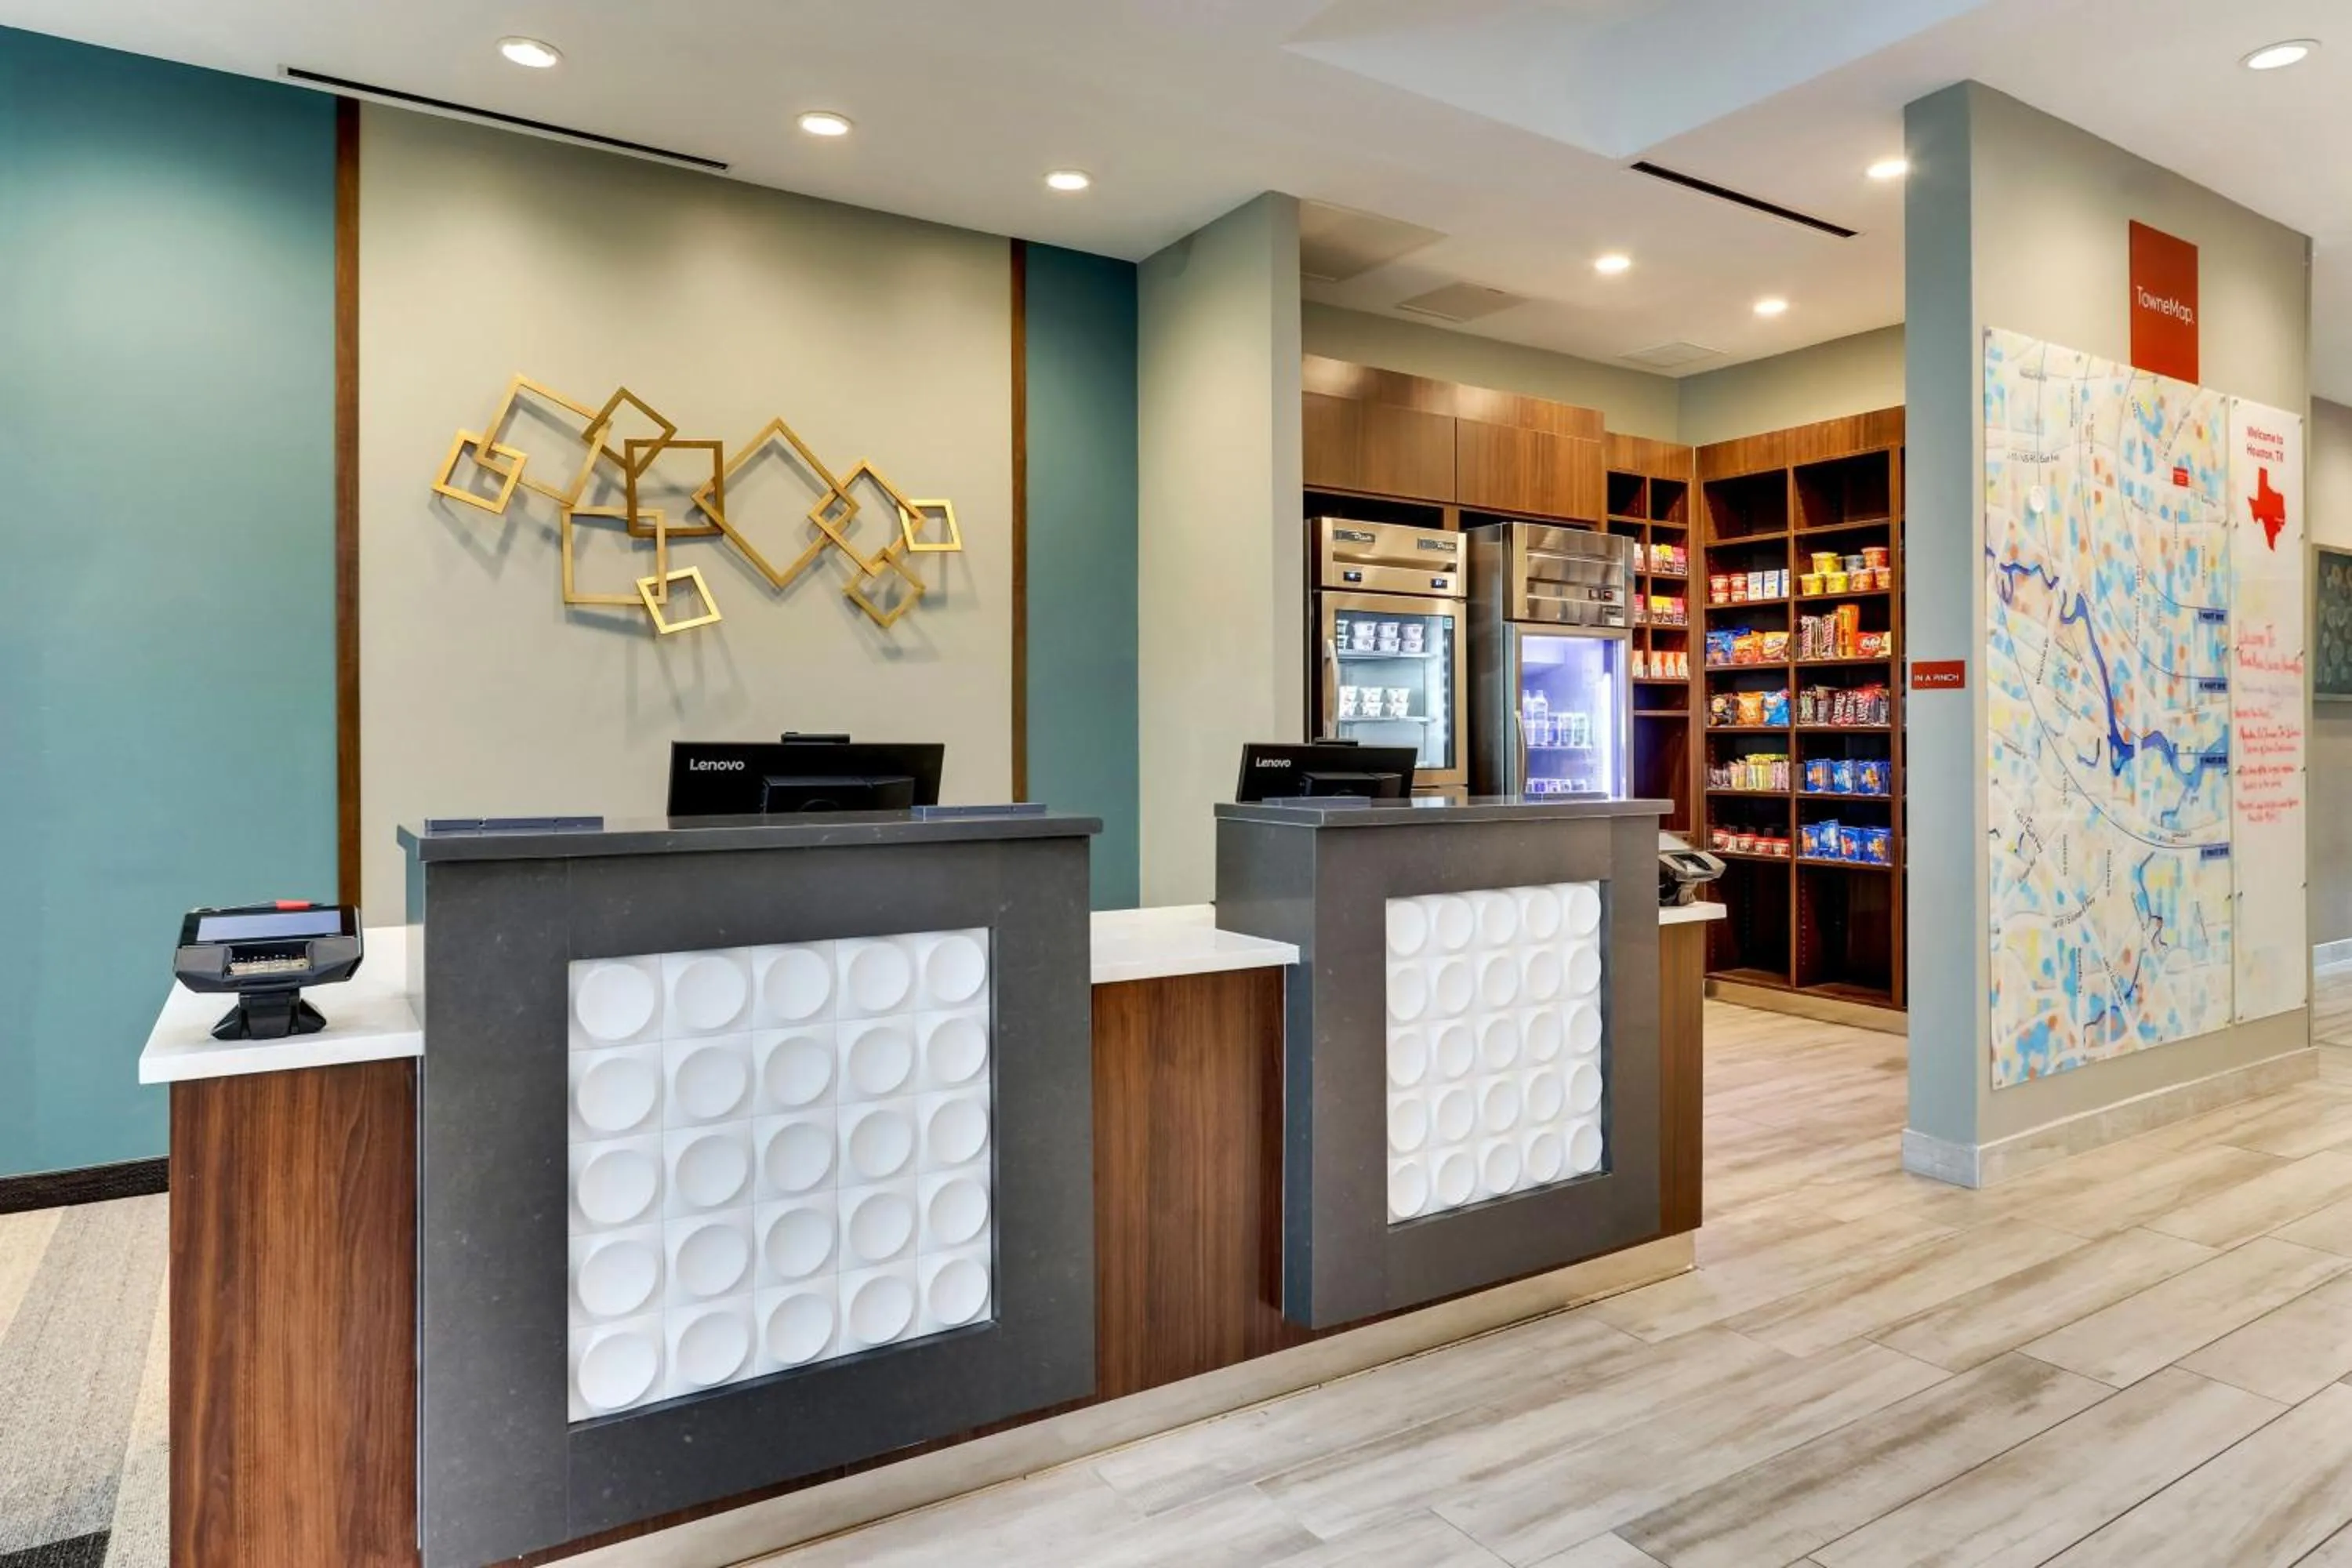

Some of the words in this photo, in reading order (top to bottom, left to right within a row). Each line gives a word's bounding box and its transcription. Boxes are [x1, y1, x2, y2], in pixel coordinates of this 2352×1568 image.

[2246, 426, 2275, 442] Welcome
[689, 757, 745, 771] Lenovo
[1255, 757, 1291, 768] Lenovo
